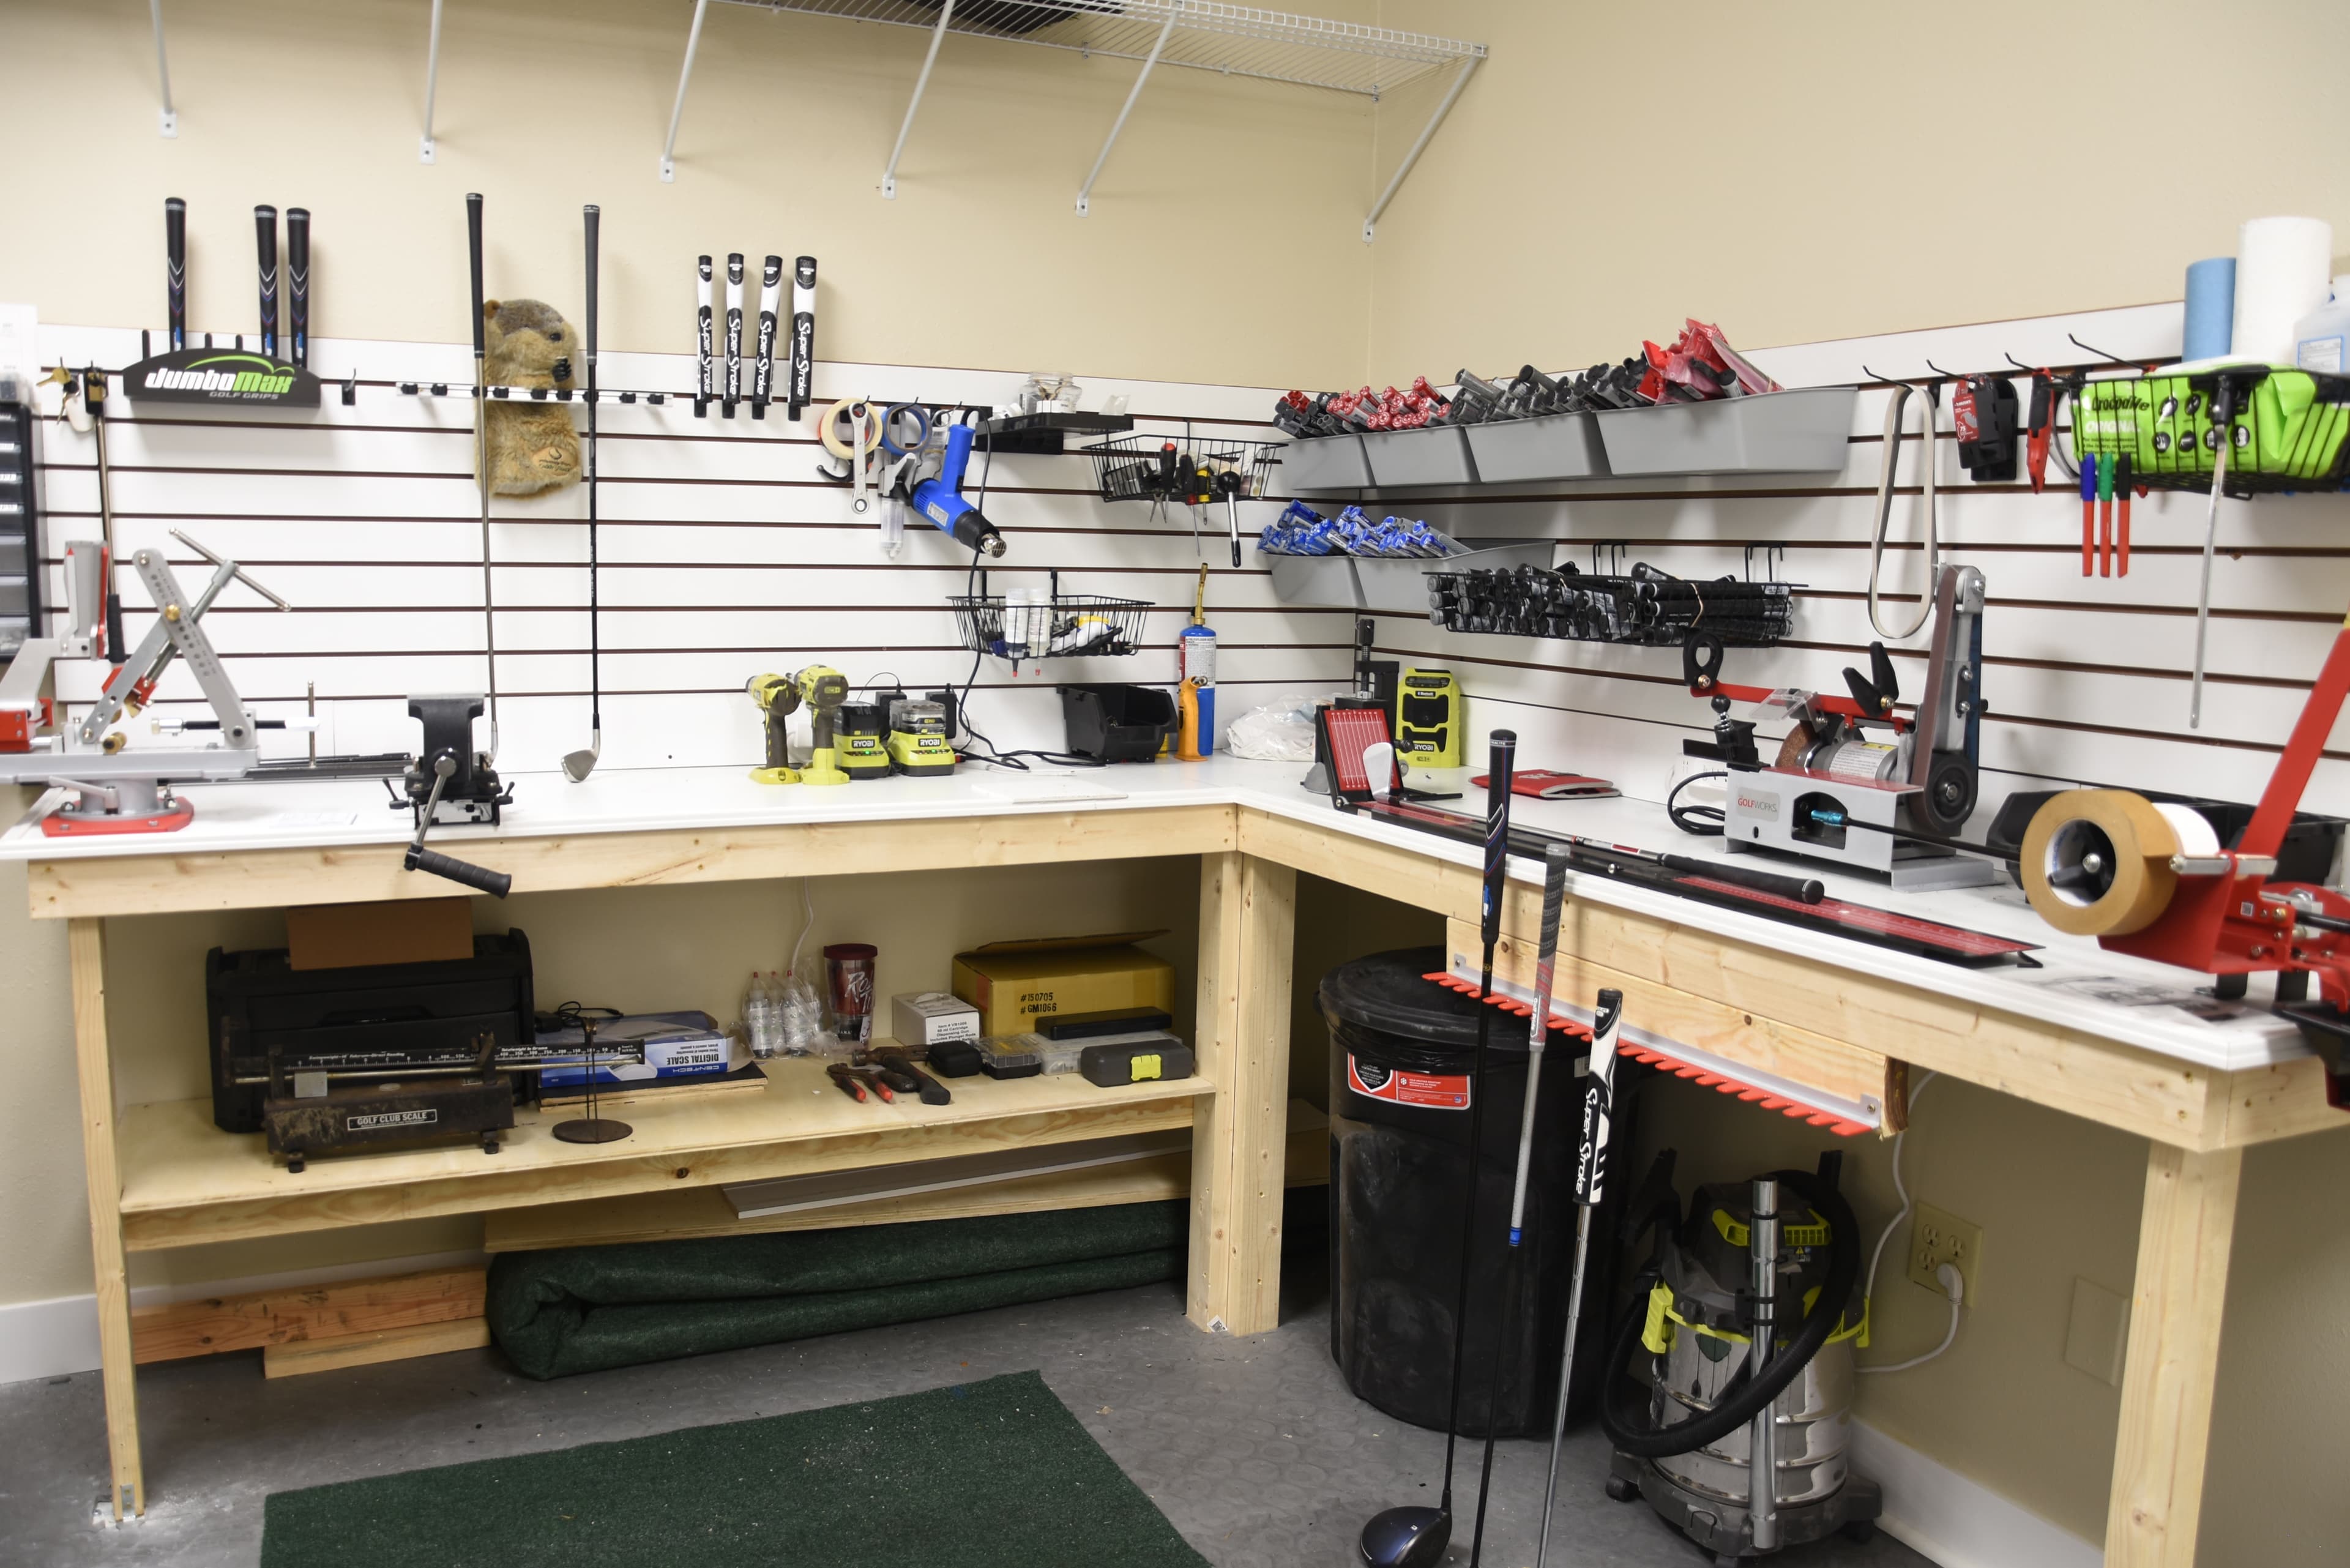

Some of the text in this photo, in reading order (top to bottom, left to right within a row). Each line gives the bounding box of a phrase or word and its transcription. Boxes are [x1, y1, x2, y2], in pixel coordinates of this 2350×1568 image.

[1028, 1002, 1057, 1013] GM1066
[692, 1053, 719, 1063] DIGITAL
[357, 1116, 378, 1126] GOLF
[379, 1114, 401, 1123] CLUB
[403, 1112, 427, 1121] SCALE
